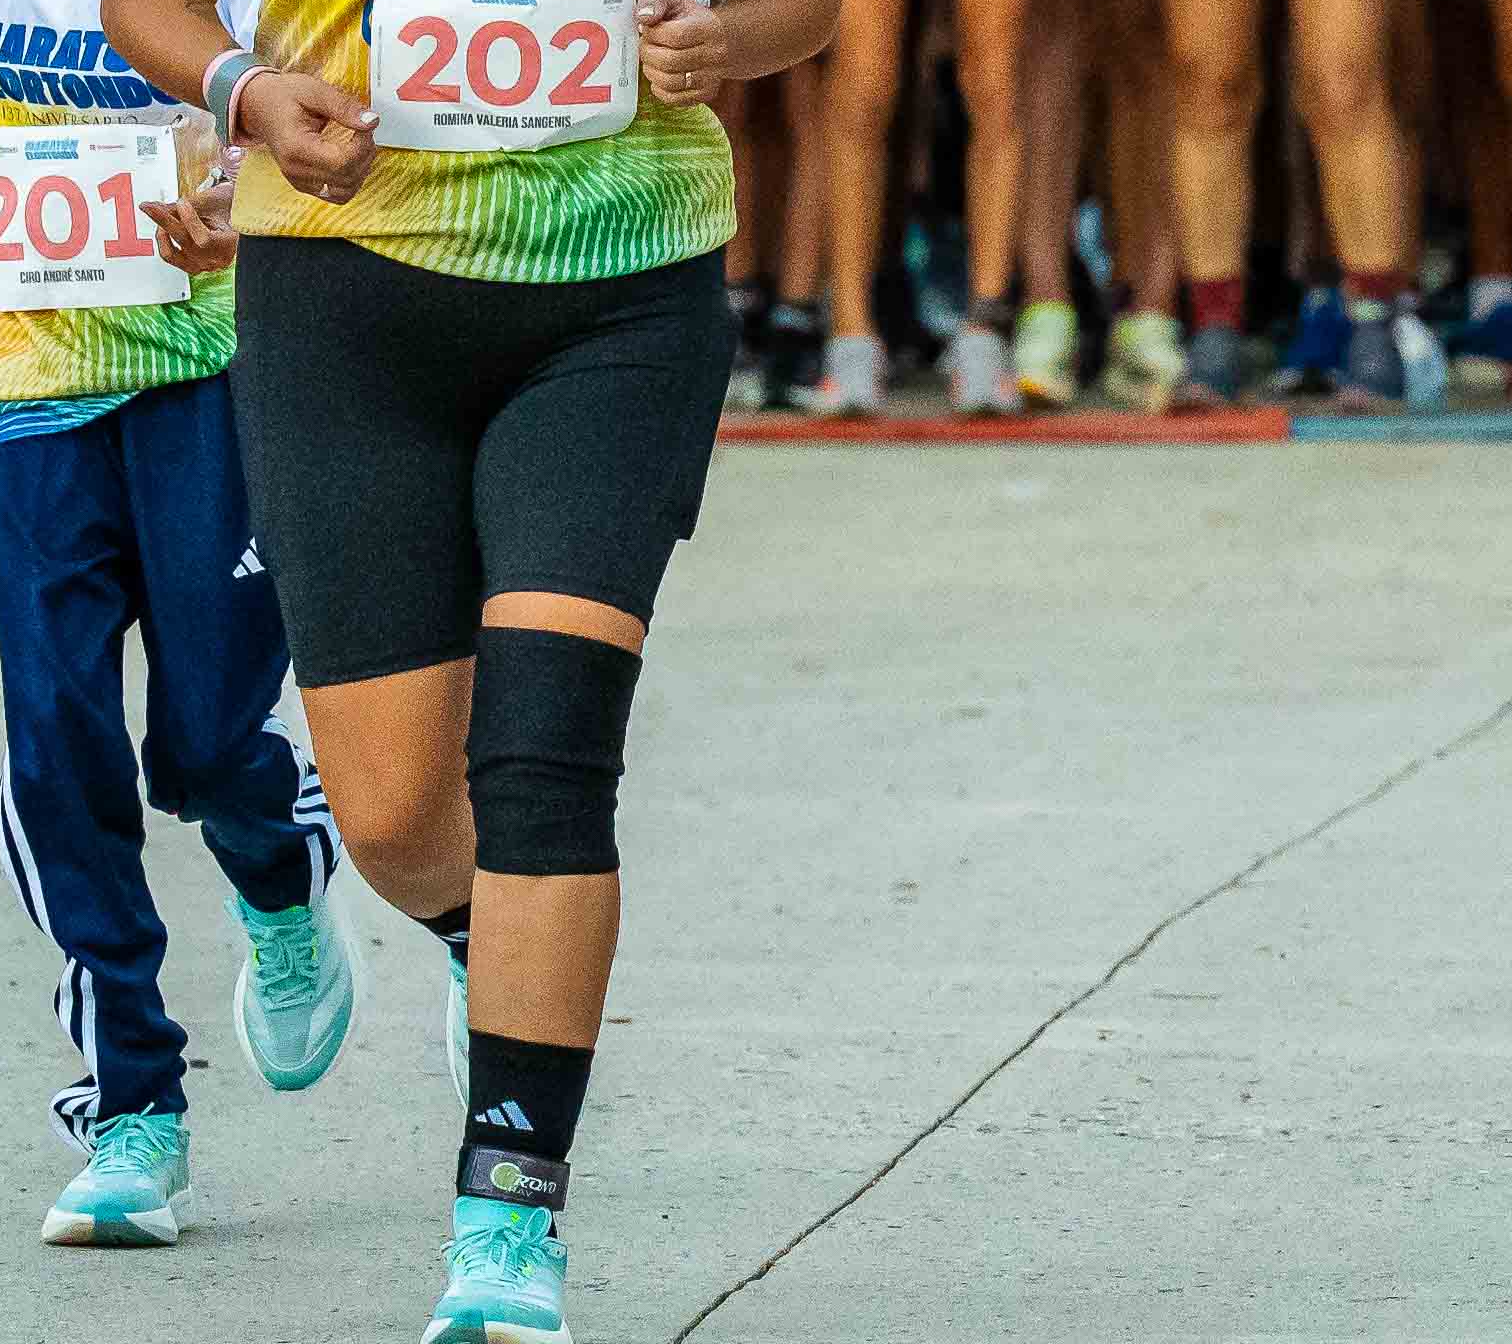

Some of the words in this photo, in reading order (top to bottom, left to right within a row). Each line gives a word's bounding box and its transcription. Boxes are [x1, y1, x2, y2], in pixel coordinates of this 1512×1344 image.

[396, 15, 612, 106] 202
[433, 113, 474, 127] ROMINA
[476, 113, 519, 129] VALERIA
[521, 115, 572, 129] SANGENIS
[20, 271, 41, 284] CIRO
[43, 267, 73, 283] ANDRÉ
[74, 269, 105, 282] SANTO
